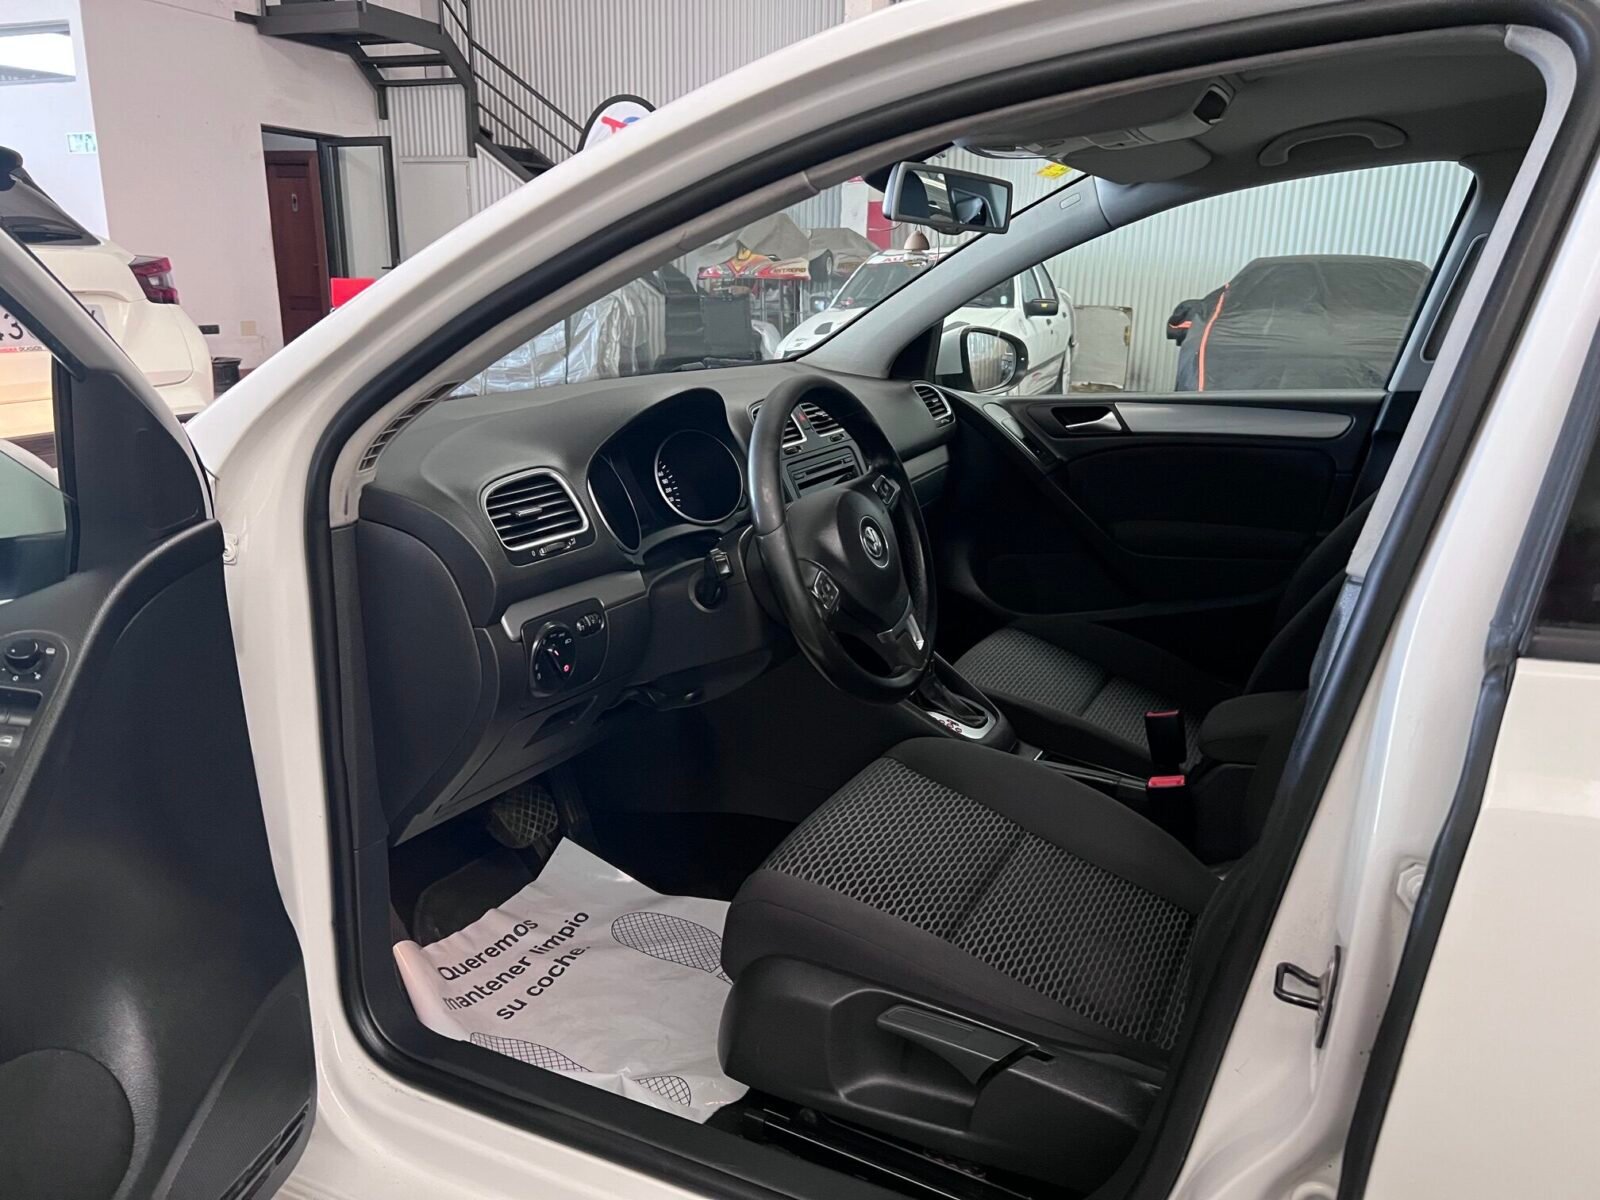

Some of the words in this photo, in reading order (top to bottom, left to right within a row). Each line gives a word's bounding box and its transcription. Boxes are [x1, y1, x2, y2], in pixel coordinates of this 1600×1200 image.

[437, 919, 539, 981] Queremos
[442, 955, 532, 1010] mantener
[528, 912, 589, 955] limpio
[496, 998, 528, 1020] su
[526, 946, 591, 997] coche.
